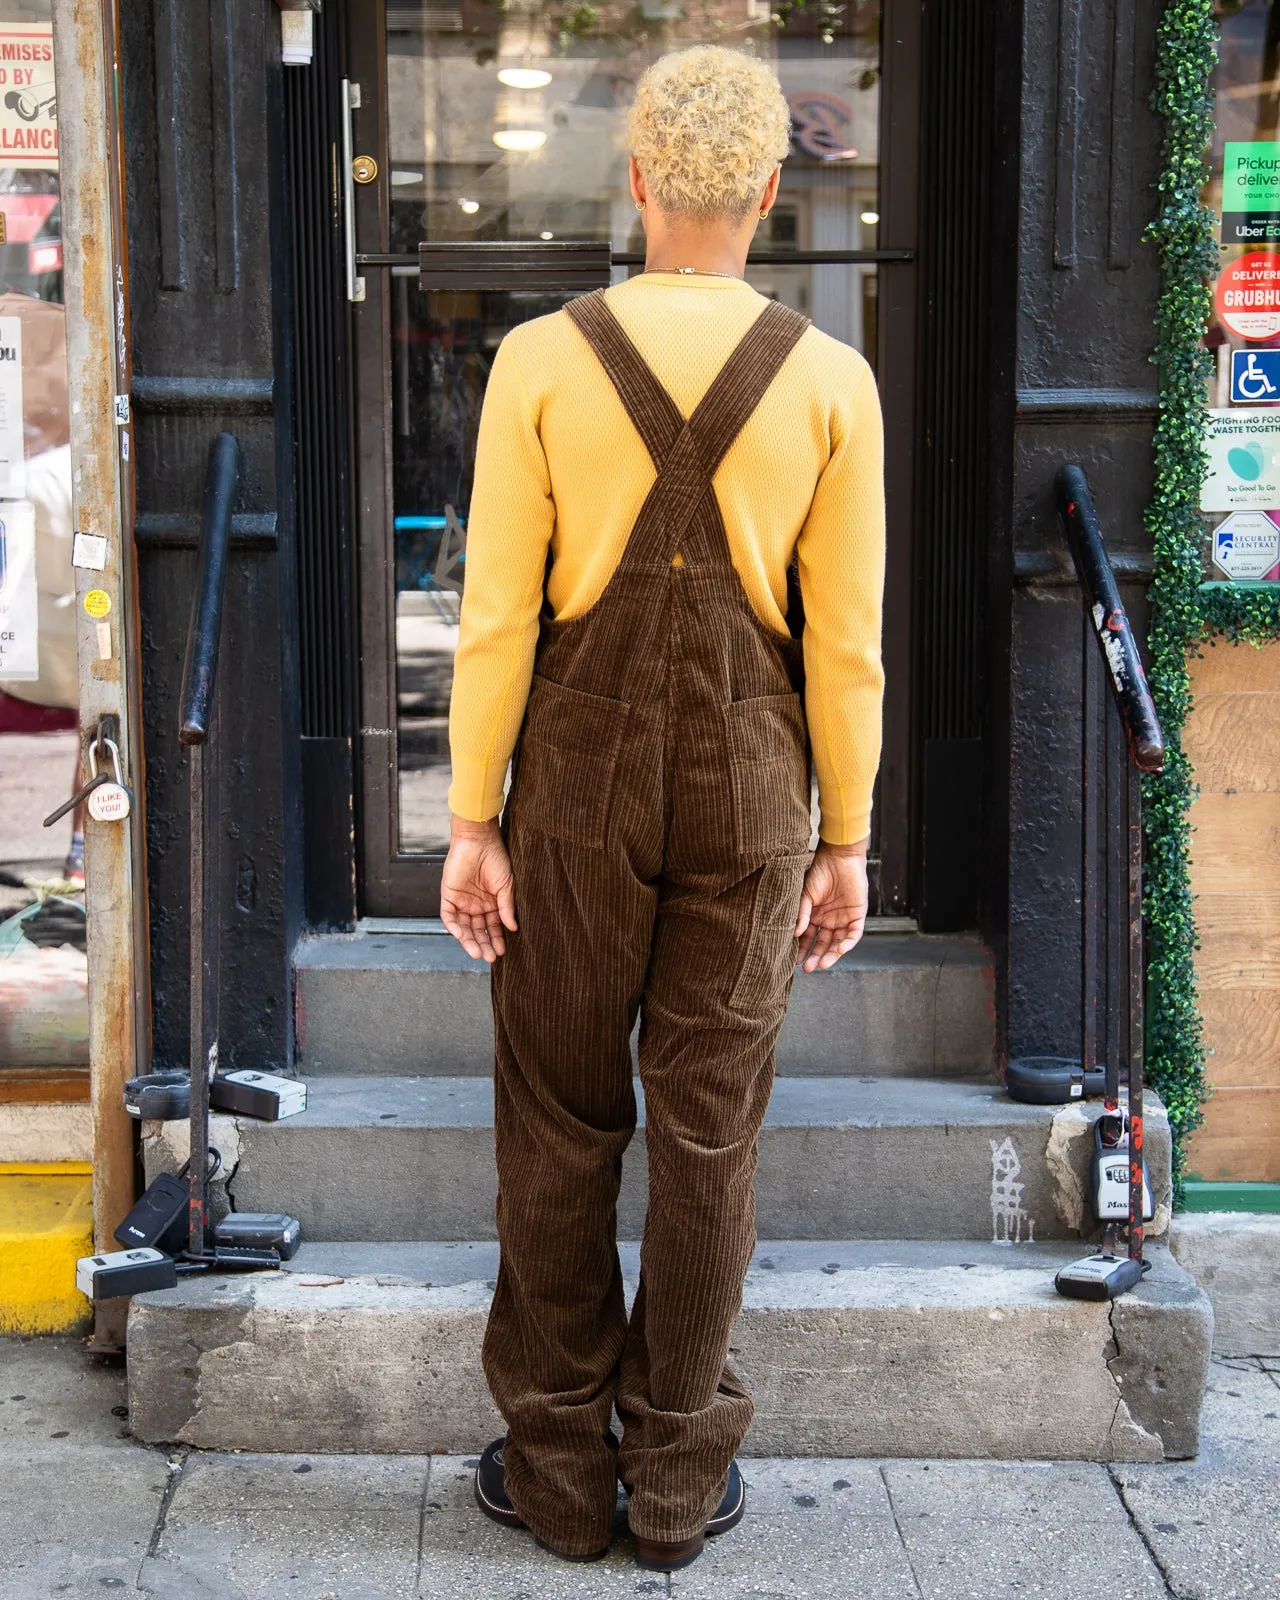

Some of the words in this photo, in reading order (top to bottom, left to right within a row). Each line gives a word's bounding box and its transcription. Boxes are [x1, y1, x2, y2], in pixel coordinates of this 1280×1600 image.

[0, 43, 52, 61] MISES
[13, 68, 33, 85] BY
[0, 127, 58, 149] LANC
[1237, 157, 1280, 172] Pickup
[1237, 173, 1280, 186] delive
[1236, 225, 1264, 237] Uber
[1213, 426, 1243, 434] WASTE
[1245, 425, 1280, 433] TOGETH
[1239, 484, 1257, 492] Good
[102, 792, 122, 803] LIKE
[100, 803, 121, 813] YOU!
[1107, 1200, 1129, 1209] Mas
